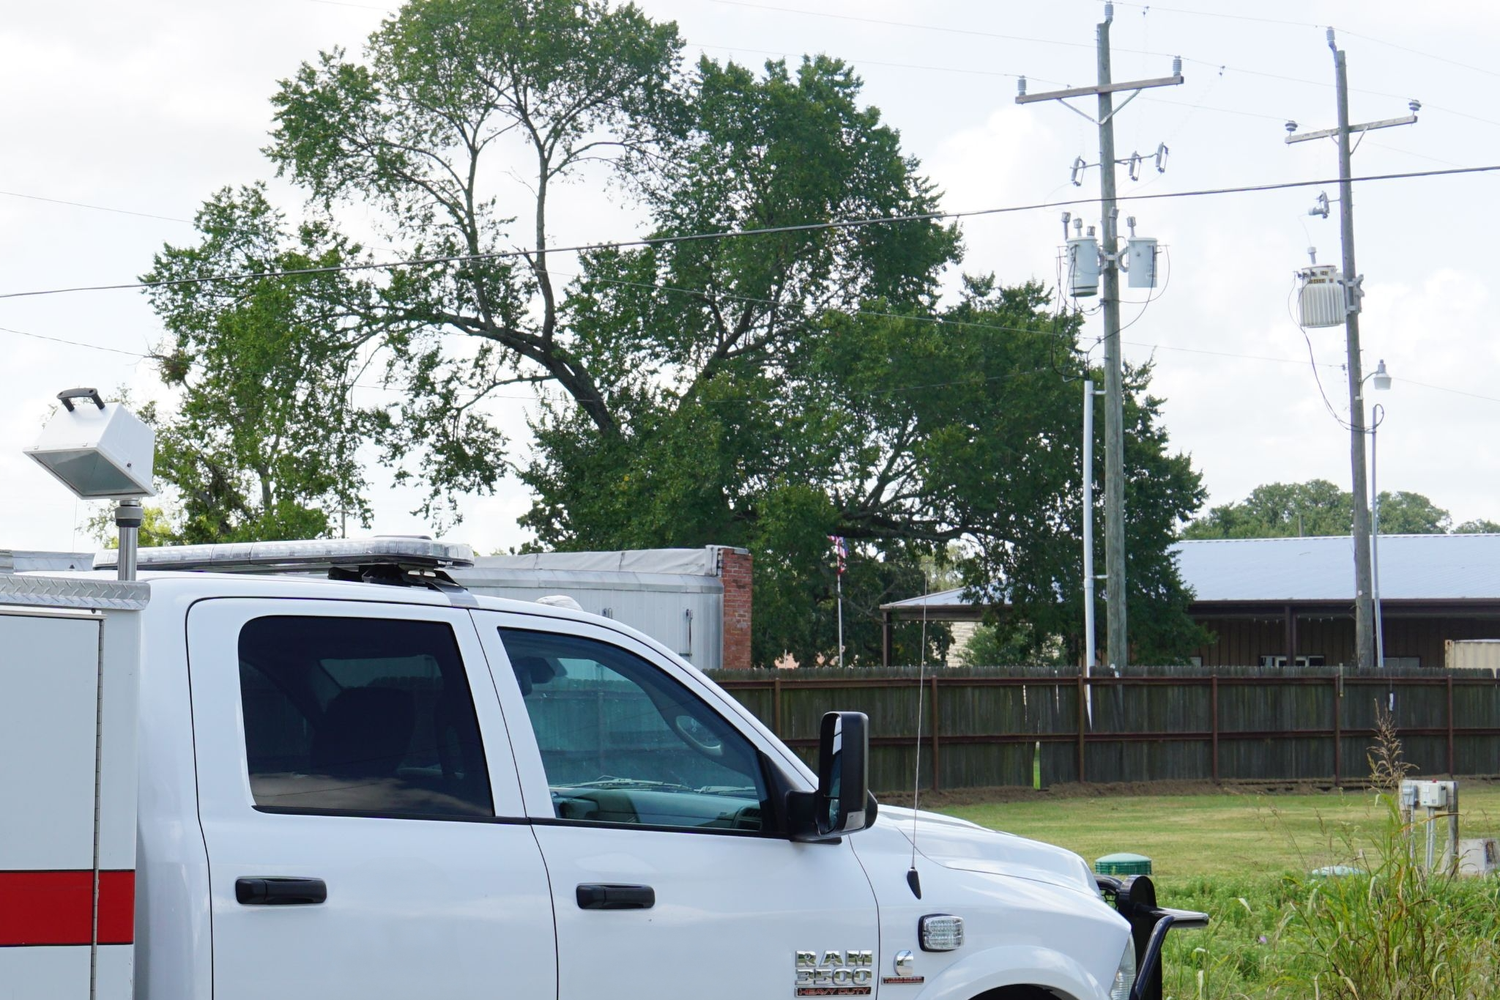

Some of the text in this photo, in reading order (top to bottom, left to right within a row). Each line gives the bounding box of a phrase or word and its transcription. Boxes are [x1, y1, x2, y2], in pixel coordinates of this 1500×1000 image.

[795, 950, 872, 967] RAM
[795, 968, 872, 986] 3500
[799, 986, 870, 996] HEAVY DUTY
